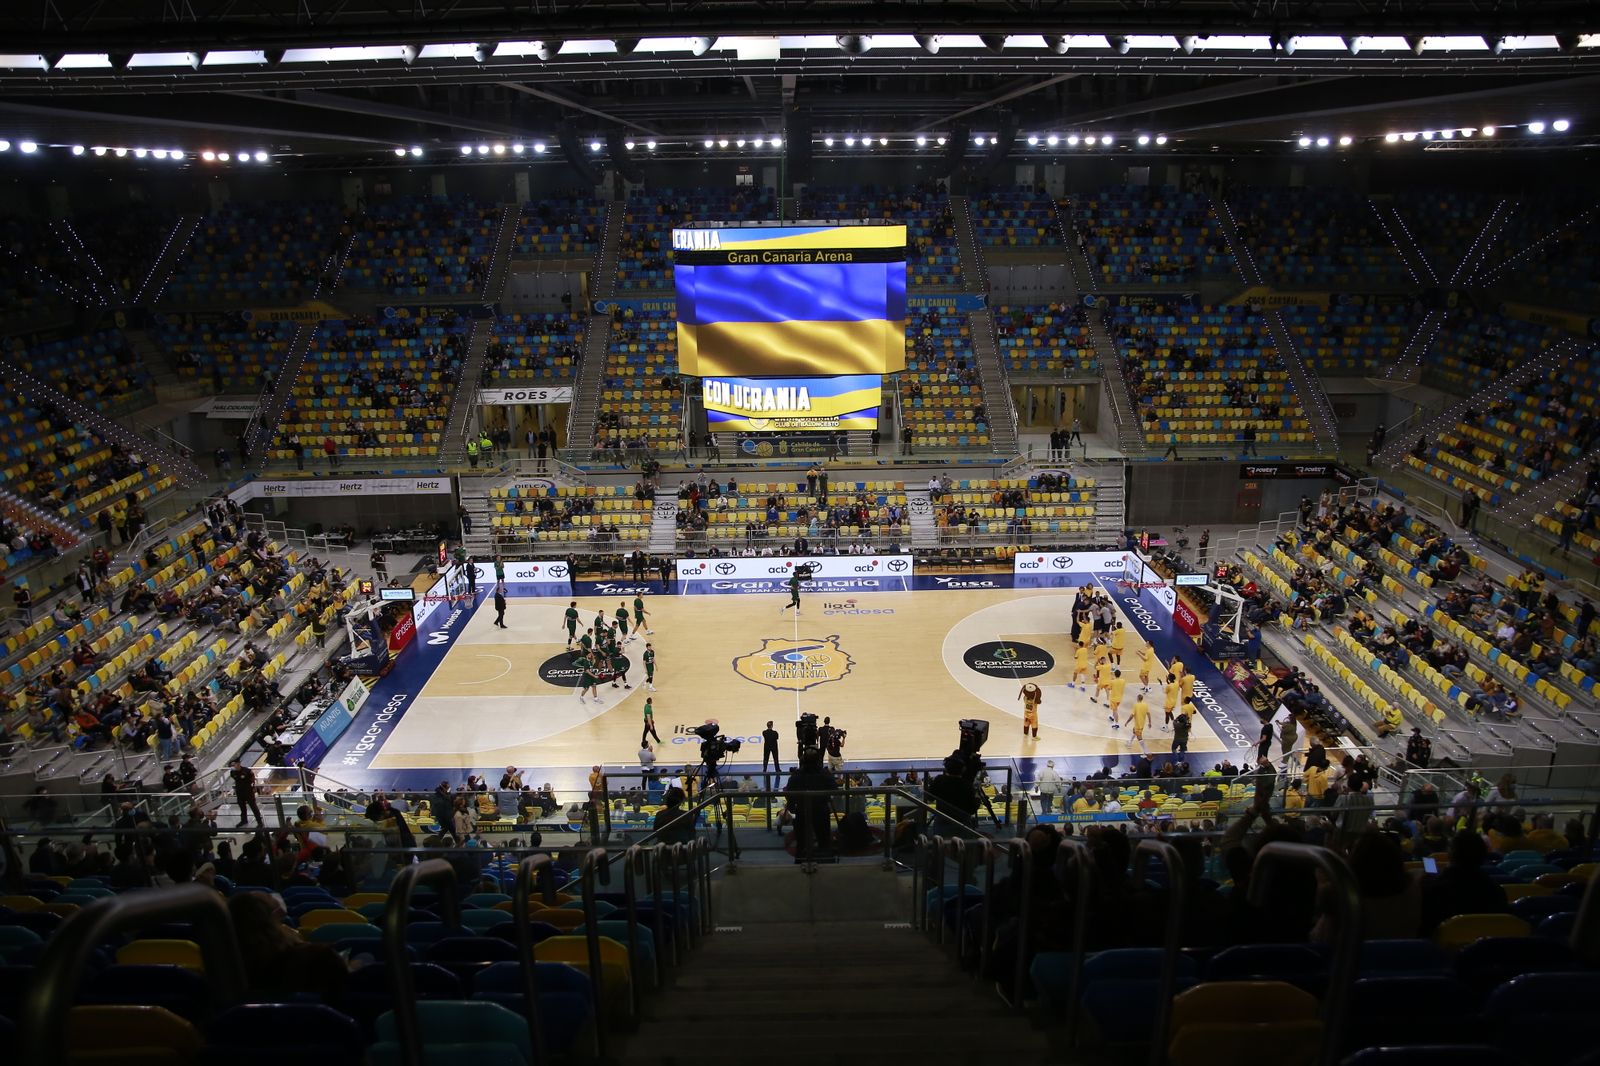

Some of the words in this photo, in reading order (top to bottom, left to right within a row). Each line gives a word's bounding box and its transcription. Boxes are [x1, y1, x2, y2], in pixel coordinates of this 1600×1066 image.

[728, 251, 758, 263] Gran
[762, 251, 811, 262] Canaria
[815, 251, 853, 262] Arena
[503, 390, 548, 401] ROES
[705, 380, 731, 407] CON
[733, 384, 811, 412] UCRANIA
[263, 484, 286, 492] Hertz
[340, 483, 362, 491] Hertz
[416, 481, 440, 489] Hertz
[1020, 560, 1039, 569] acb
[1104, 560, 1124, 568] acb
[516, 569, 536, 578] acb
[682, 567, 702, 575] acb
[768, 566, 788, 574] acb
[711, 580, 773, 590] Gran
[780, 578, 880, 589] Canaria
[824, 602, 855, 610] liga
[824, 608, 895, 616] endesa
[1124, 597, 1163, 631] endesa
[1176, 604, 1195, 626] endesa
[440, 608, 463, 630] Movistar
[395, 617, 414, 640] endesa
[775, 662, 814, 671] GRAN
[765, 669, 828, 679] CANARIA
[319, 706, 342, 732] ATLANTIS
[1192, 680, 1253, 748] #ligaendesa
[341, 694, 408, 766] #ligaendesa
[674, 724, 700, 736] lig
[671, 735, 762, 745] enesa
